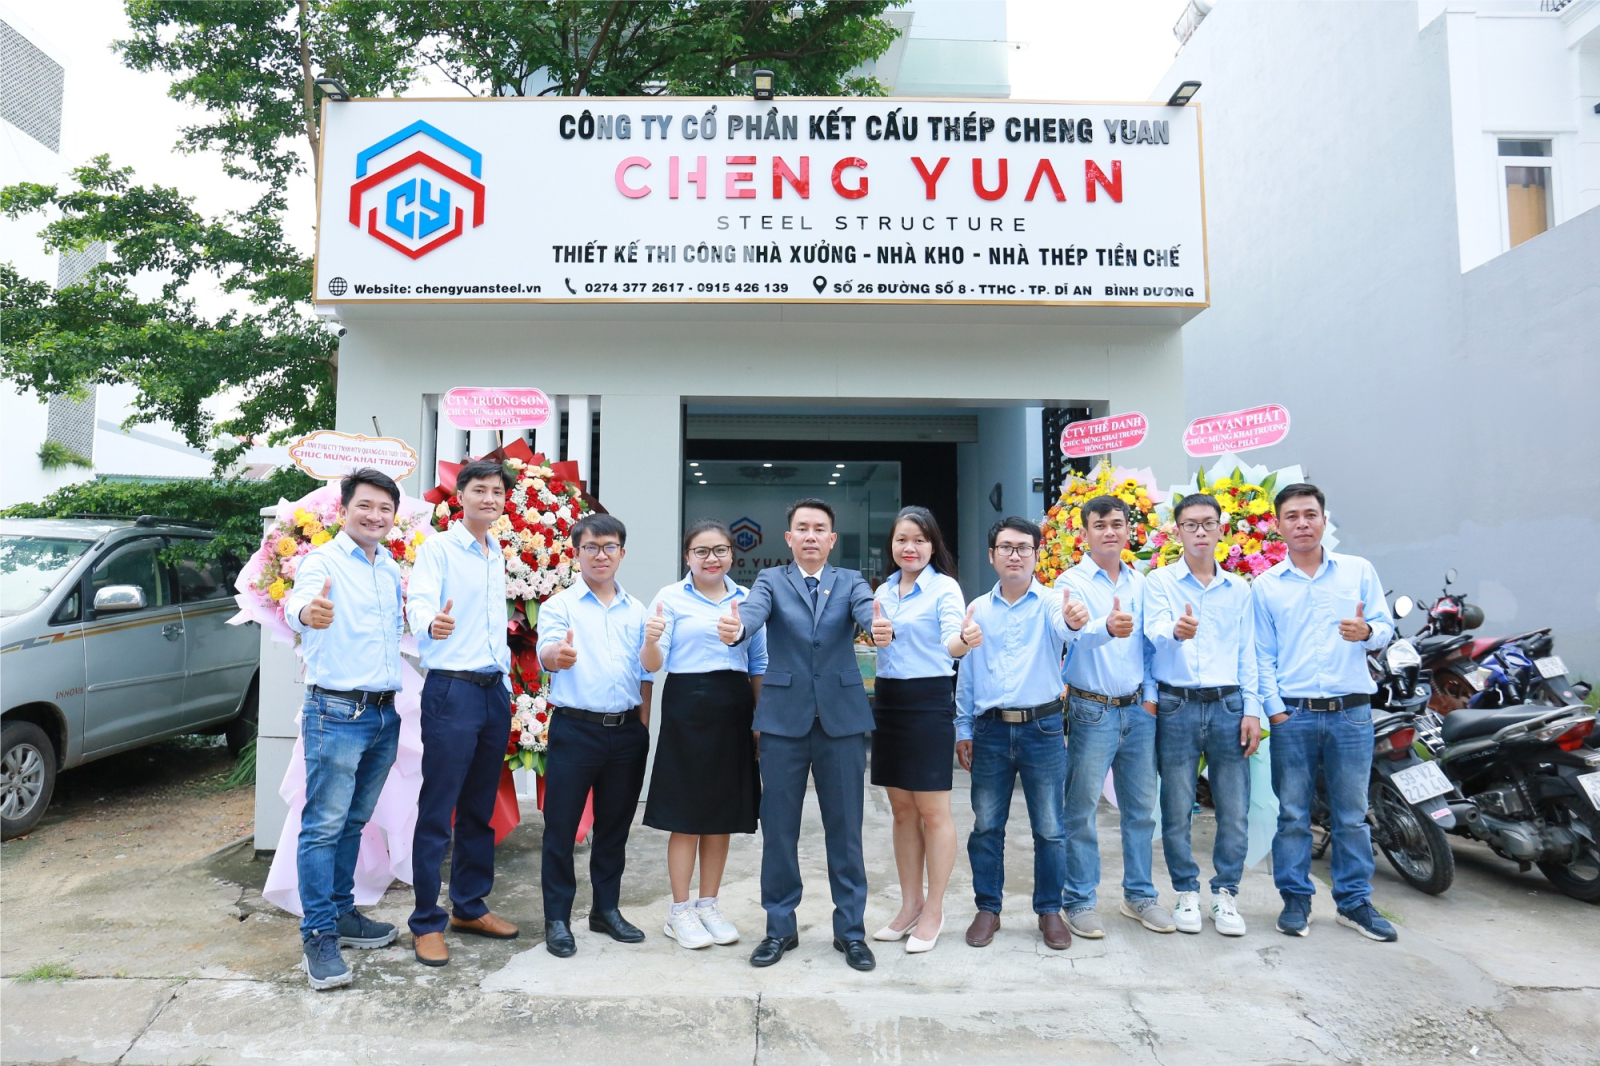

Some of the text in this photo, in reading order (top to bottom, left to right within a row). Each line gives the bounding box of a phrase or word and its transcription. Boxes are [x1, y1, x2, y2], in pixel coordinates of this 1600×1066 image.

[559, 104, 1170, 144] CÔNG TY CỔ PHẦN KẾT CẤU THÉP CHENG YUAN
[614, 155, 1123, 203] CHENG YUAN
[717, 215, 1025, 231] STEEL STRUCTURE
[552, 240, 607, 263] THIẾT
[614, 239, 641, 263] KẾ
[645, 245, 676, 263] THI
[683, 241, 736, 263] CÔNG
[743, 241, 782, 263] NHÀ
[790, 239, 856, 263] XƯỞNG
[877, 242, 916, 264] NHÀ
[924, 246, 964, 264] KHO
[989, 244, 1029, 265] NHÀ
[1038, 244, 1088, 266] THÉP
[1095, 242, 1137, 266] TIỀN
[1143, 244, 1181, 267] CHẾ
[354, 283, 541, 295] Website: chengyuansteel.vn
[585, 283, 618, 292] 0274
[622, 283, 647, 292] 377
[652, 283, 684, 292] 2617
[697, 283, 730, 292] 0915
[734, 283, 759, 292] 426
[764, 283, 789, 292] 139
[833, 279, 853, 293] SỐ
[857, 284, 873, 293] 26
[877, 281, 930, 294] ĐƯỜNG
[935, 280, 954, 294] SỐ
[958, 284, 966, 294] 8
[979, 284, 1016, 294] TTHC
[1029, 285, 1050, 295] TP.
[1055, 282, 1068, 295] DĨ
[1073, 285, 1092, 295] AN
[1105, 284, 1138, 296] BÌNH
[1143, 286, 1194, 297] DƯƠNG
[447, 393, 544, 406] CTY TRƯỜNG SƠN
[495, 407, 514, 416] KHAI
[1065, 417, 1141, 439] CTY THẾ DANH
[1189, 408, 1282, 436] CTY VẠN PHÁT
[1101, 432, 1118, 441] KHAI
[1233, 429, 1253, 439] KHAI
[1105, 440, 1123, 449] PHÁT
[1237, 437, 1260, 447] PHÁT
[353, 455, 377, 464] KHAI
[56, 686, 83, 699] INNOVA
